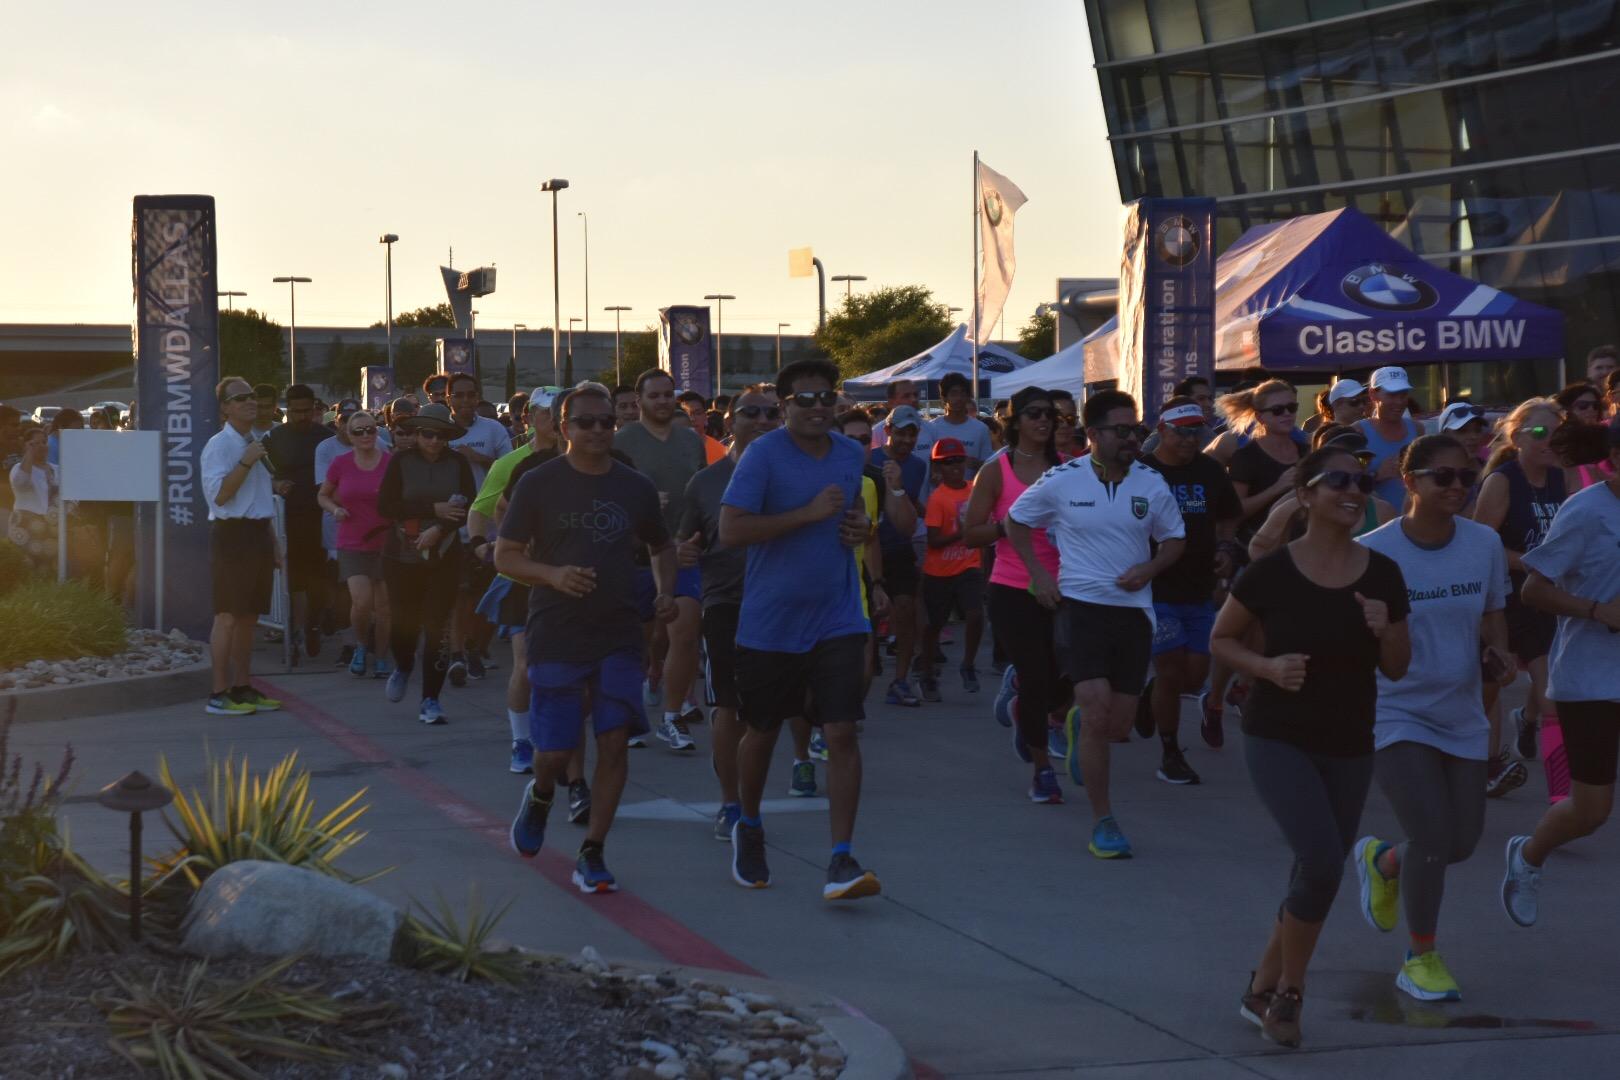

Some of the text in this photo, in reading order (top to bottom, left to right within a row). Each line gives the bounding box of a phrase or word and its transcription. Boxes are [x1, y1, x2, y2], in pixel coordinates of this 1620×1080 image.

[1158, 279, 1176, 378] Marathon
[1299, 319, 1527, 356] Classic BMW
[160, 222, 194, 526] #RUNBMWDALLAS
[1451, 581, 1482, 597] BMW
